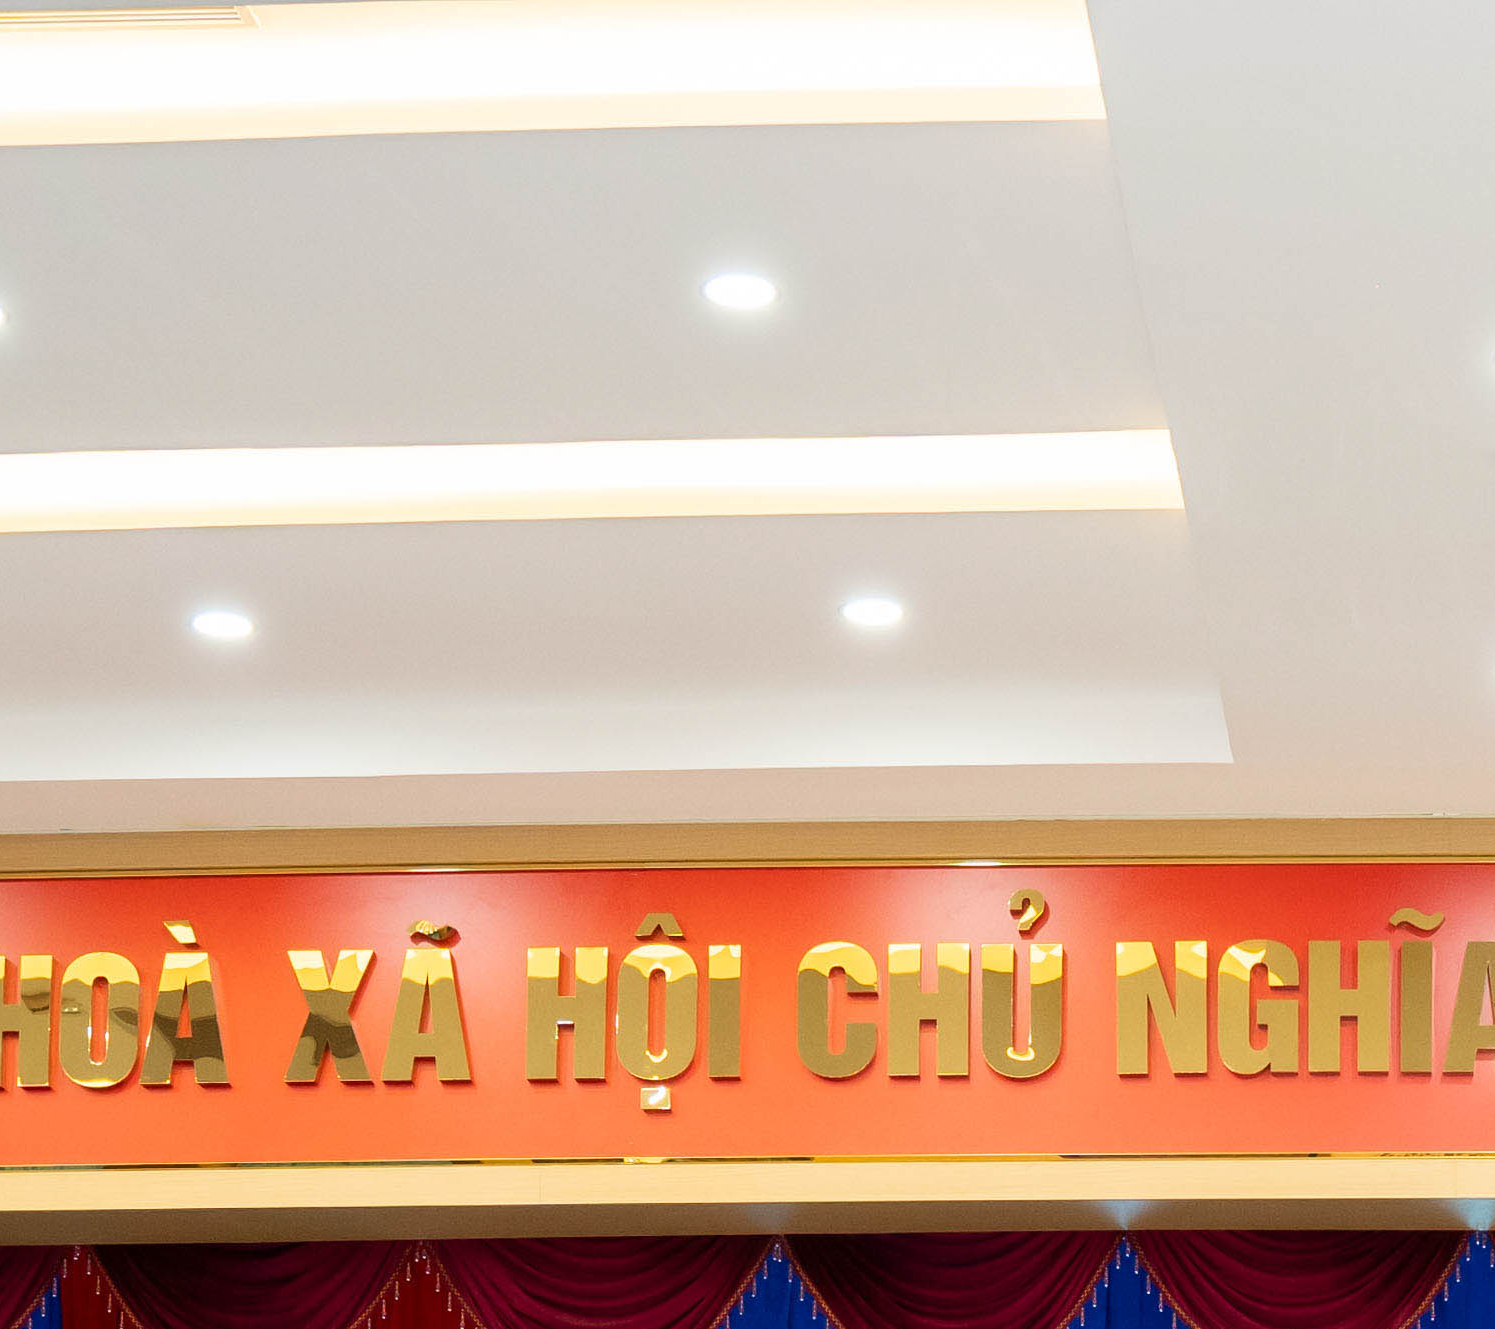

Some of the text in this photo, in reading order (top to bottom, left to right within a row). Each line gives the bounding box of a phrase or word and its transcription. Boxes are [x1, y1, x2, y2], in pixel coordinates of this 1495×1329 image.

[284, 920, 472, 1081] XÃ
[525, 913, 742, 1110] HỘI
[797, 888, 1065, 1078] CHỦ
